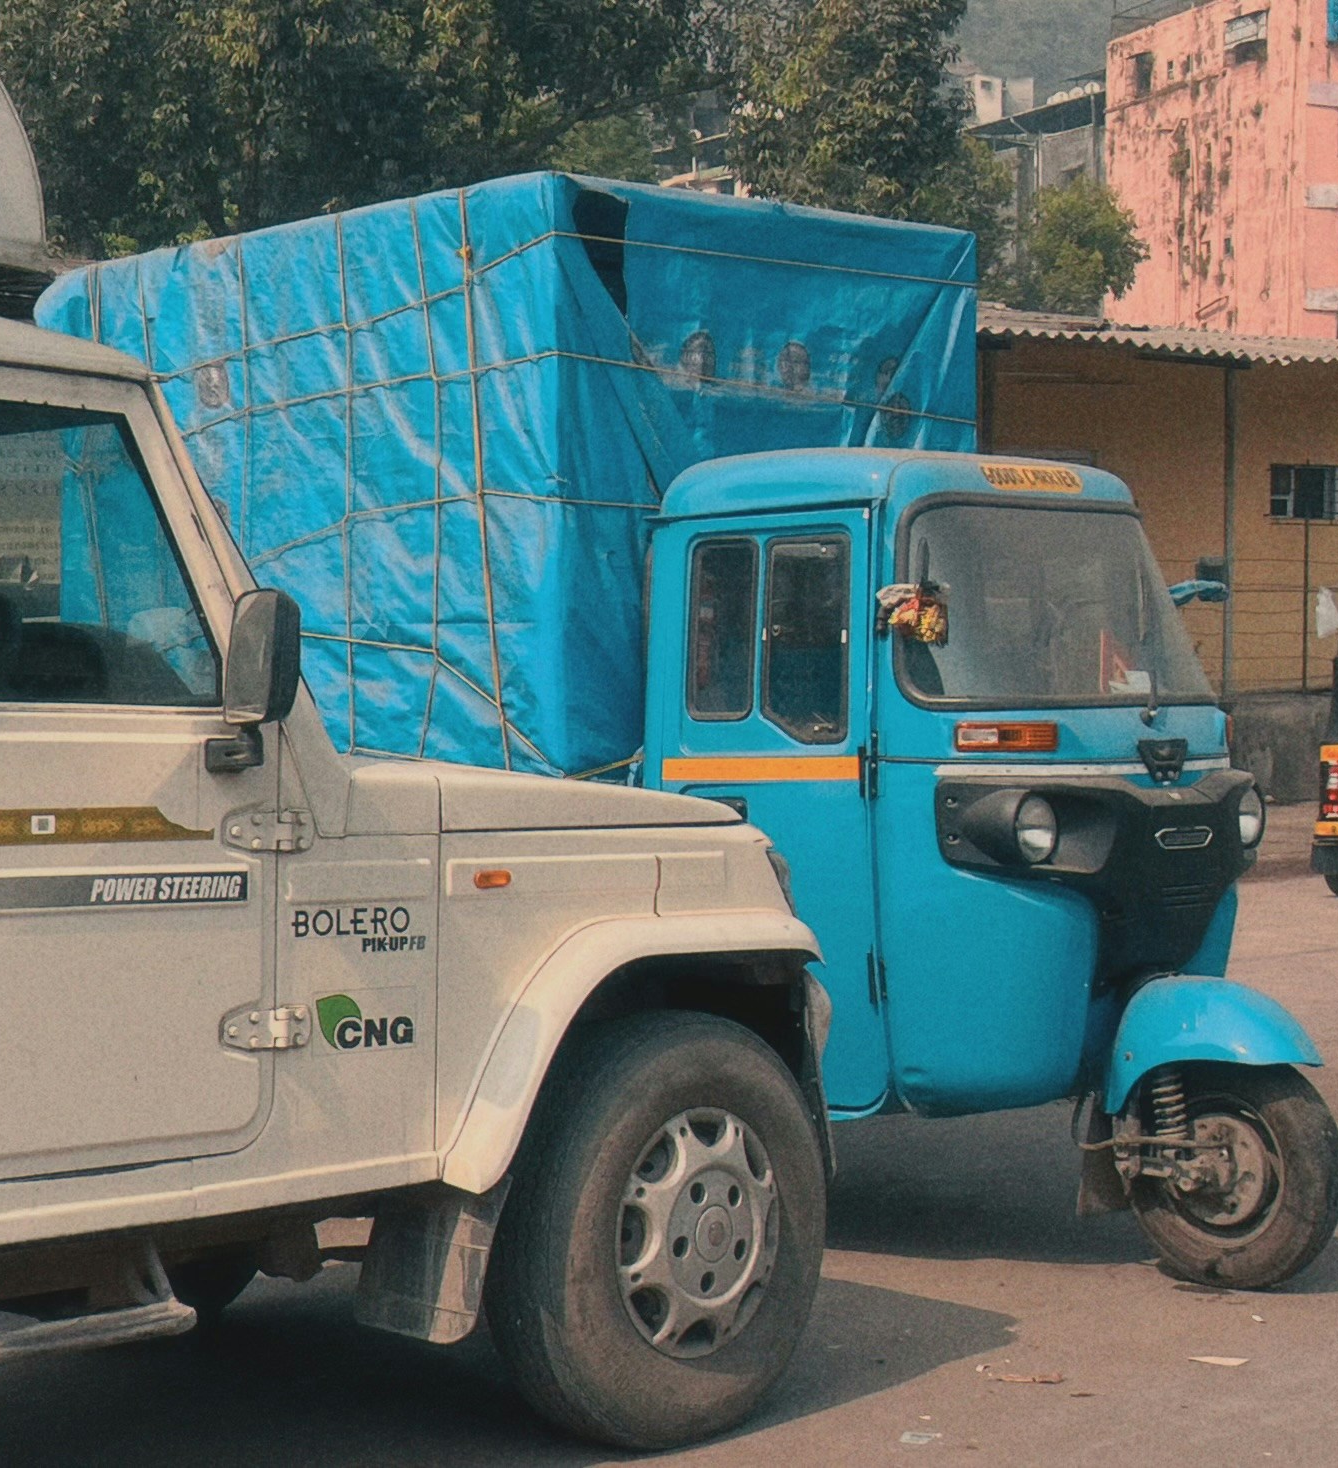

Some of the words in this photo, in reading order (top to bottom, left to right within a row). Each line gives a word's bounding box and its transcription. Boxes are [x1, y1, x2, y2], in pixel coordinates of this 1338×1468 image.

[1022, 468, 1080, 488] CARRIER
[90, 878, 157, 902] POWER
[158, 875, 242, 900] STEERING
[291, 906, 410, 937] BOLERO
[336, 1016, 414, 1049] CNG
